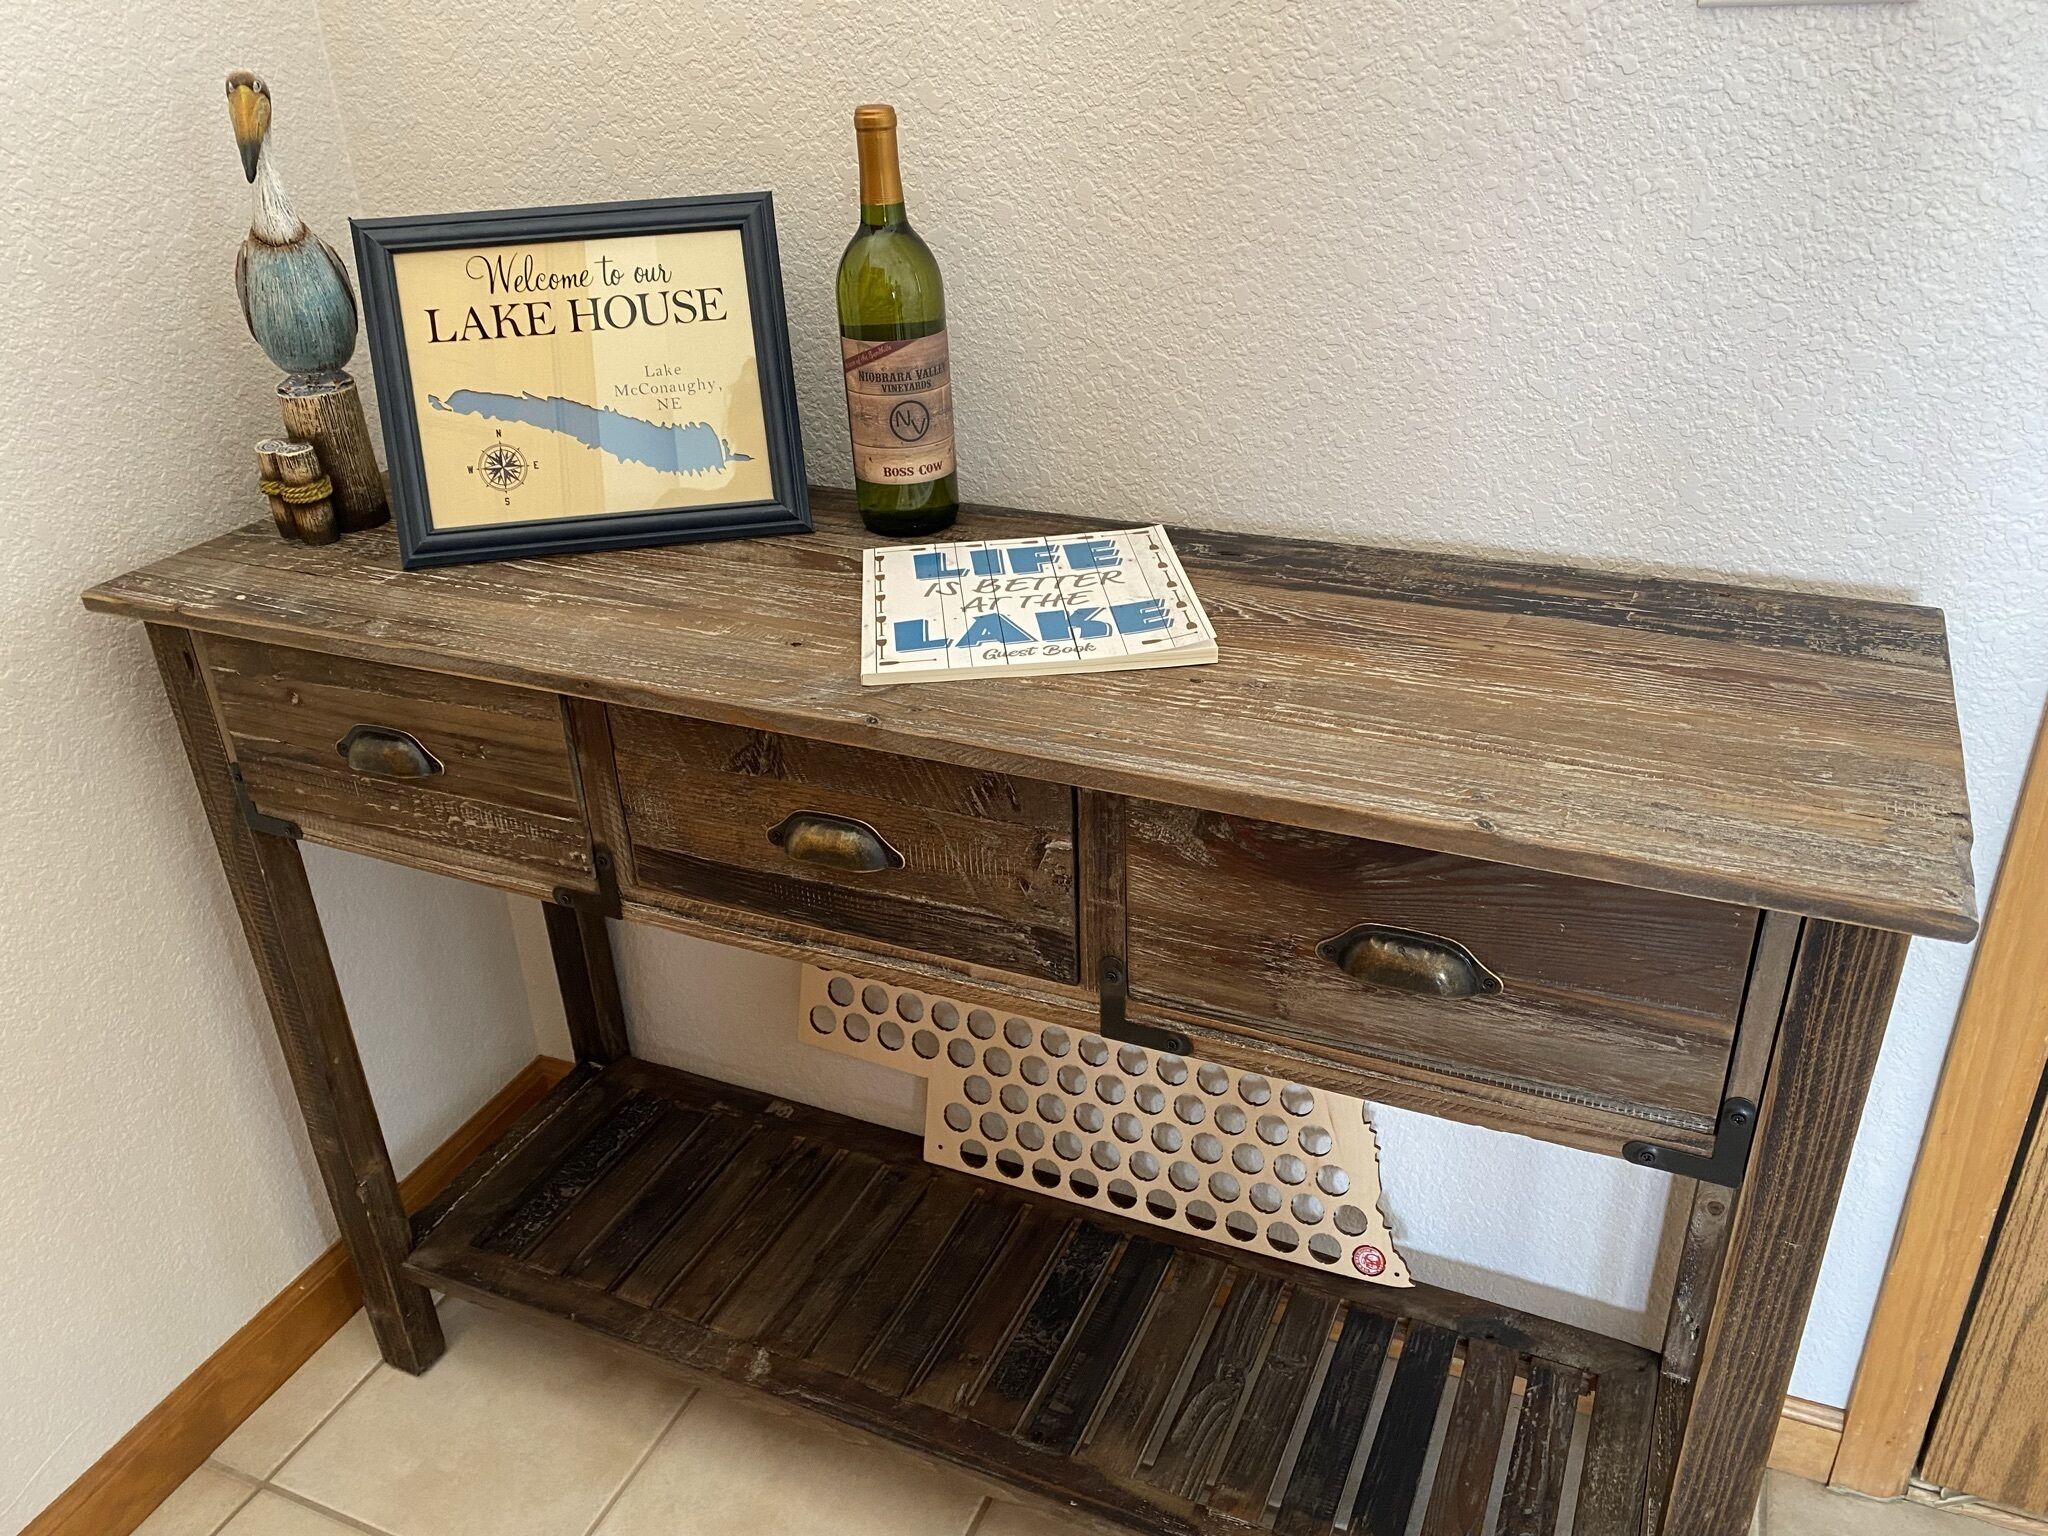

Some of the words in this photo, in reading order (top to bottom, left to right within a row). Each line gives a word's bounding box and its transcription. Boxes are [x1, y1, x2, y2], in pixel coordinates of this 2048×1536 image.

[466, 252, 594, 294] Welcome
[594, 255, 624, 287] to
[634, 262, 673, 284] our
[424, 301, 556, 343] LAKE
[567, 287, 728, 333] HOUSE
[644, 364, 682, 378] Lake
[858, 370, 912, 383] NIOBRARA
[915, 363, 946, 380] VALLEY
[614, 379, 723, 398] McConaughy,
[881, 379, 932, 393] VINEYARDS
[657, 397, 682, 411] NE
[496, 429, 502, 438] N
[467, 465, 474, 474] W
[533, 460, 539, 470] E
[883, 465, 914, 477] BOSS
[919, 461, 943, 476] COW
[504, 497, 511, 506] S
[913, 539, 1123, 580] LIFE
[923, 580, 960, 597] IS
[972, 570, 1126, 594] BETTER
[960, 594, 1011, 613] AT
[1020, 590, 1094, 609] THE
[894, 598, 1175, 653] LAKE
[982, 646, 1040, 661] Guest
[1042, 642, 1097, 656] Book
